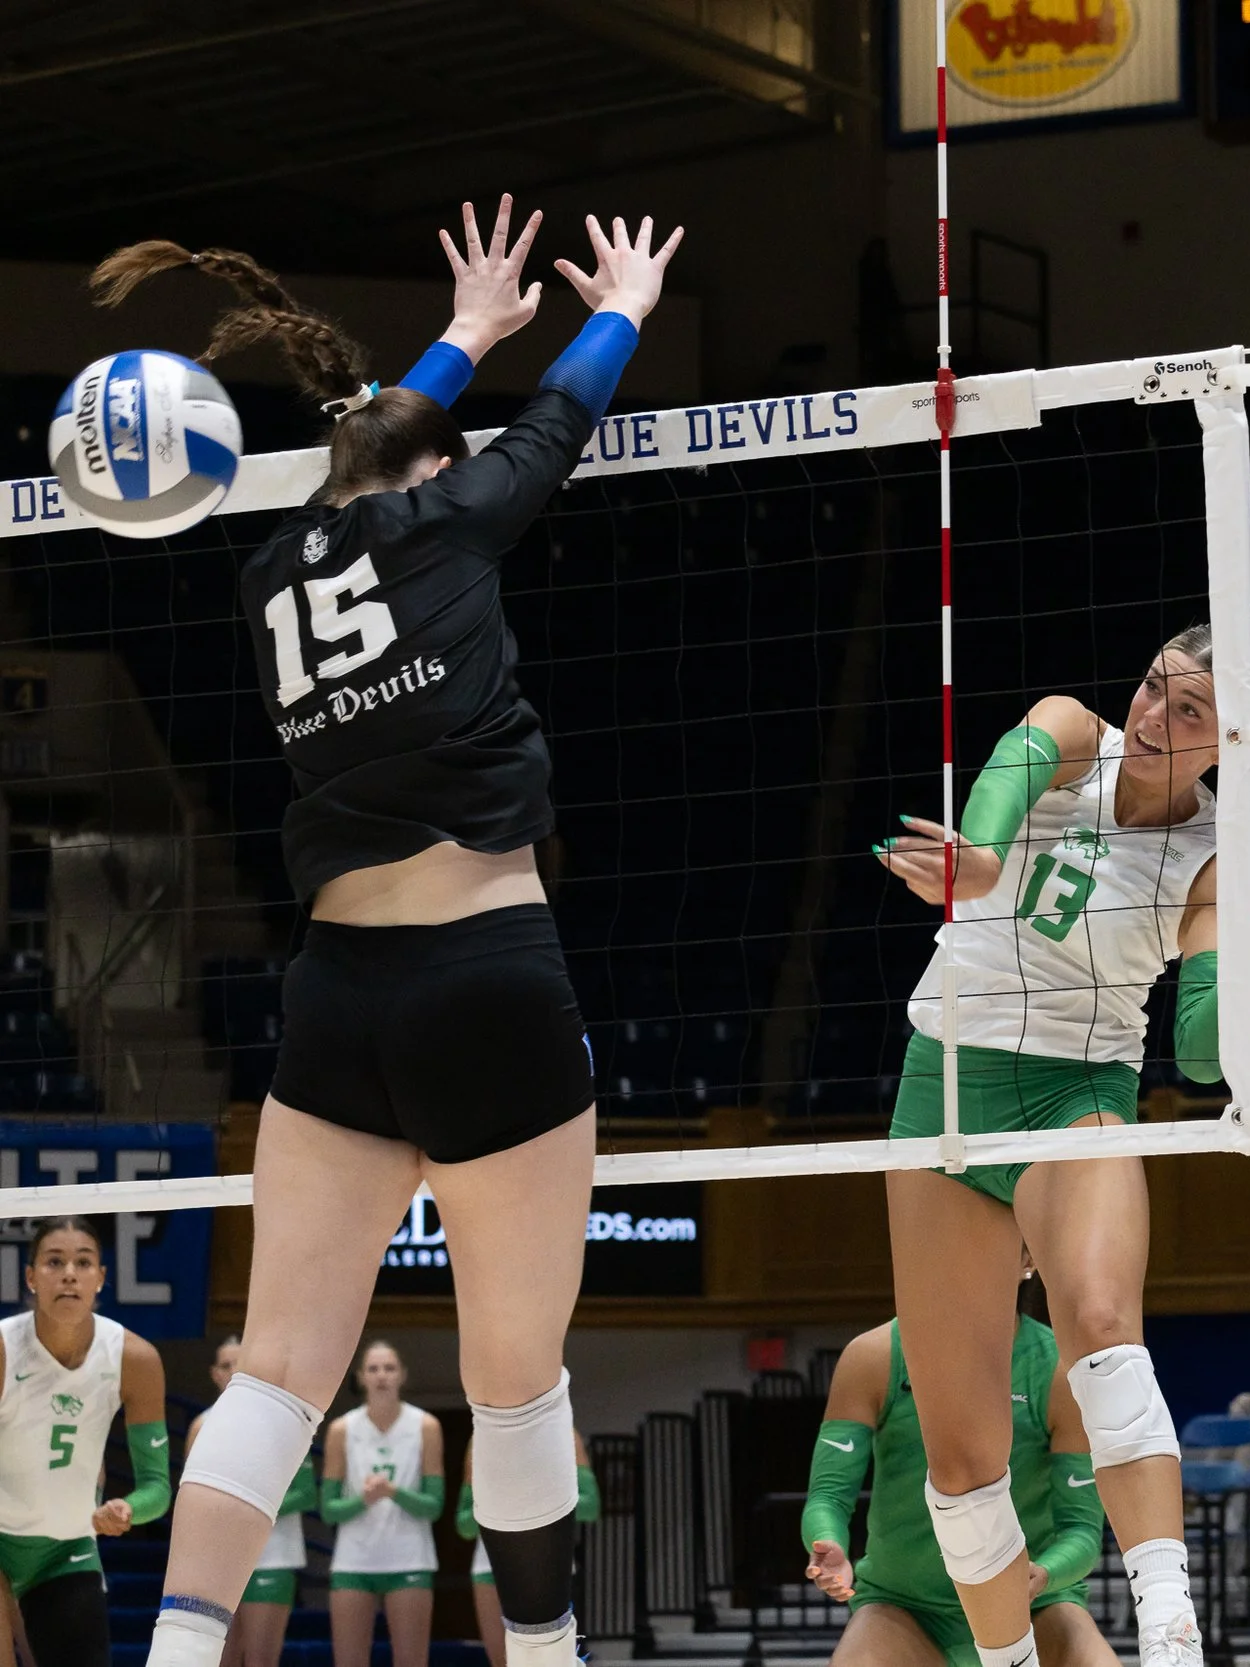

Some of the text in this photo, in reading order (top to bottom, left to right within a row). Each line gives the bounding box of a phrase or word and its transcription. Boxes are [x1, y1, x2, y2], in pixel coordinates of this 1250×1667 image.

[938, 223, 946, 291] sports imports
[911, 392, 980, 410] sport ports
[1166, 359, 1213, 374] Senoh
[76, 375, 107, 474] molten
[578, 391, 858, 464] UE DEVILS
[265, 552, 398, 709] 15
[327, 655, 446, 724] Devils
[1016, 853, 1096, 942] 13
[49, 1424, 77, 1469] 5
